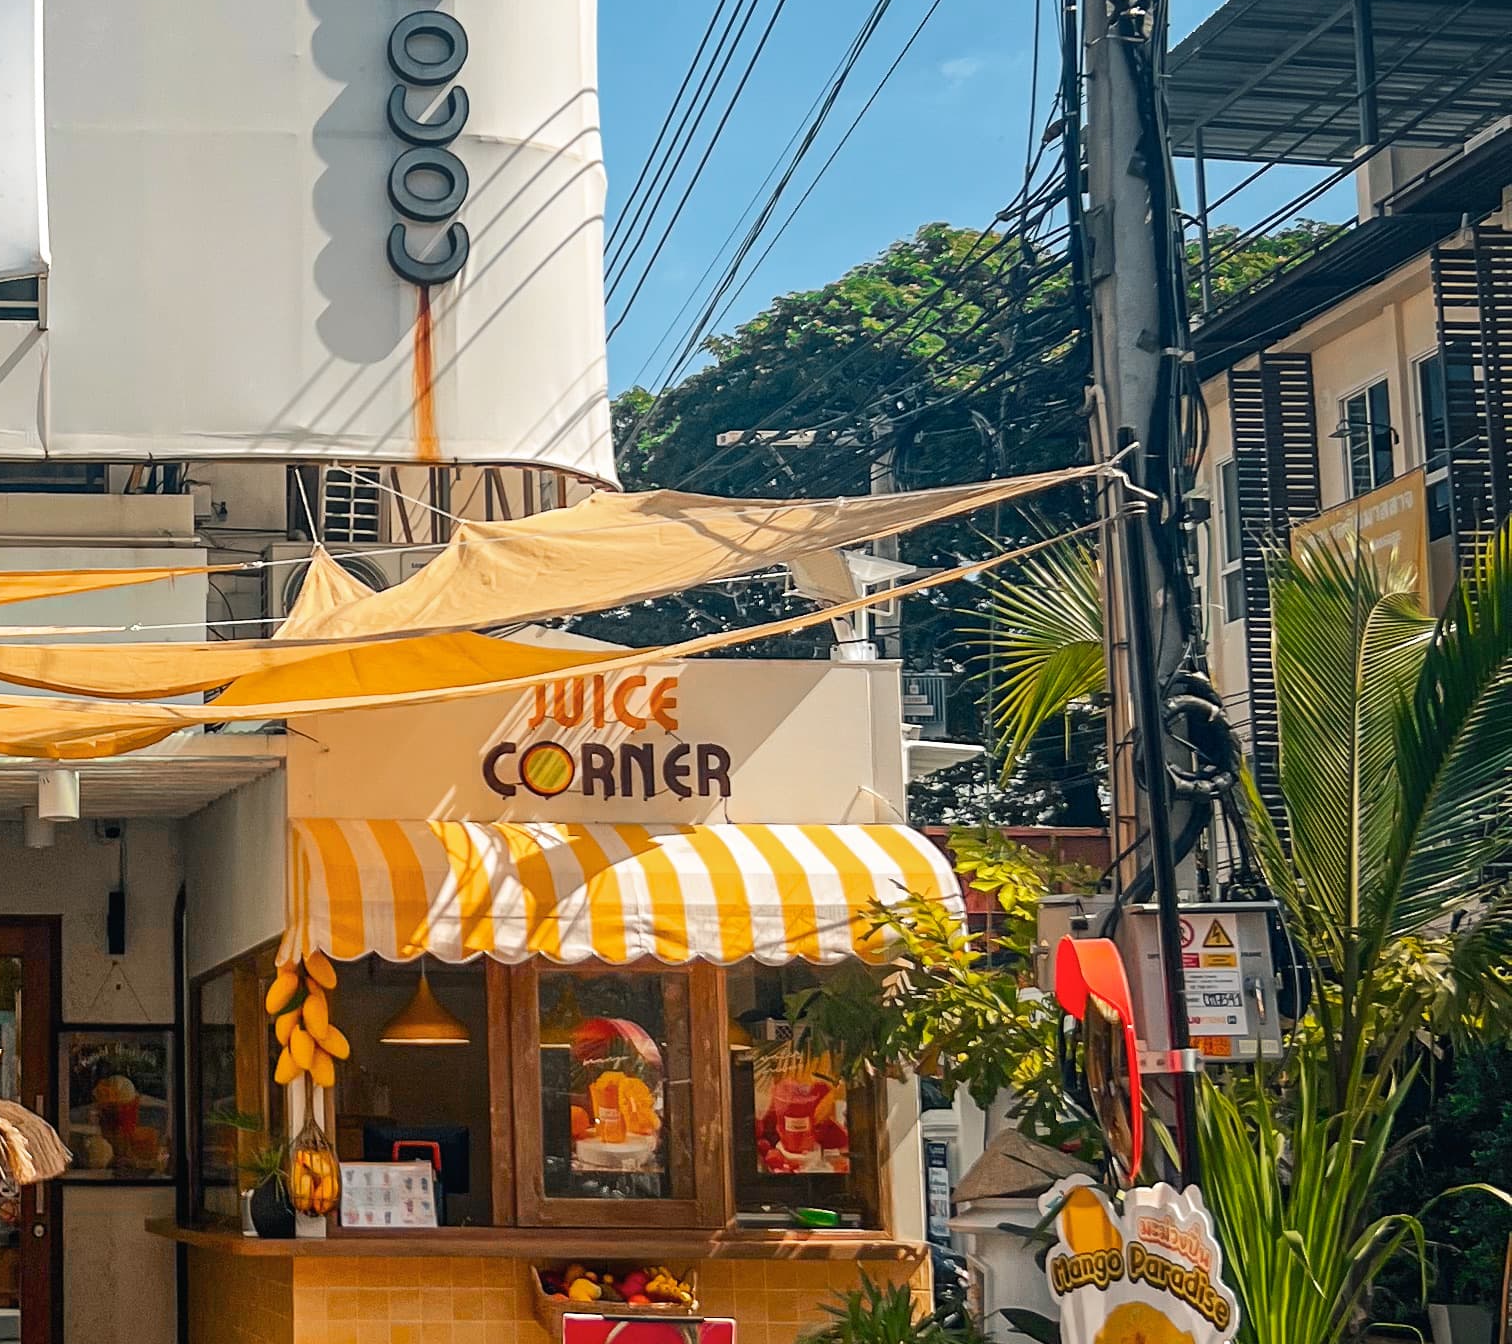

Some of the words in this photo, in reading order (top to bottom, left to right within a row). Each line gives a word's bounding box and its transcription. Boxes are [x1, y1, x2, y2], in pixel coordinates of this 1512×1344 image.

[388, 8, 469, 286] COCO
[528, 675, 680, 732] JUICE
[483, 741, 732, 799] CORNER
[1052, 1248, 1124, 1295] Mango
[1126, 1241, 1230, 1331] Paradise
